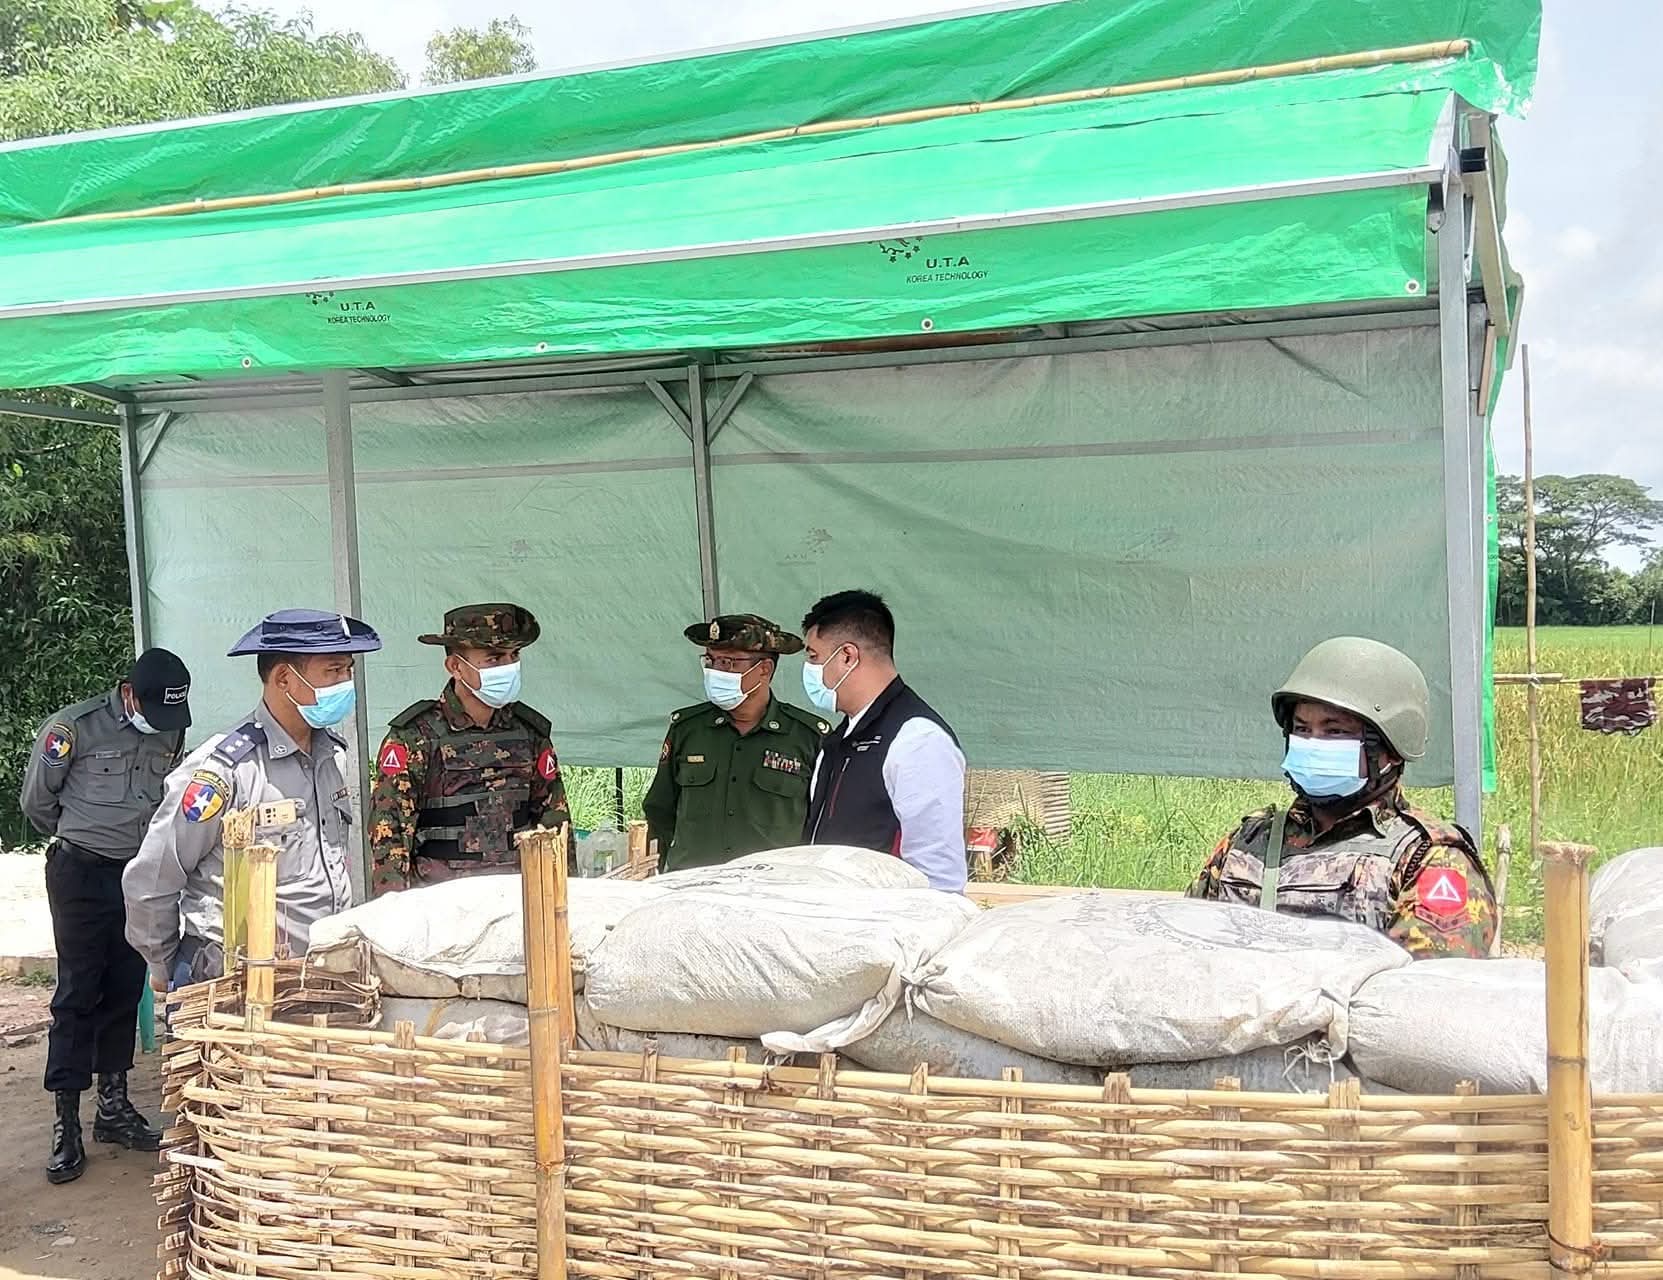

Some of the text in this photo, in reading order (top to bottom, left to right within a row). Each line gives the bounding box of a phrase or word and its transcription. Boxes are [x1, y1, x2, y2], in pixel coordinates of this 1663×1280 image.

[926, 256, 970, 269] U.T.A
[906, 270, 989, 284] KOREA TECHNOLOGY
[340, 301, 375, 311] U.T.A
